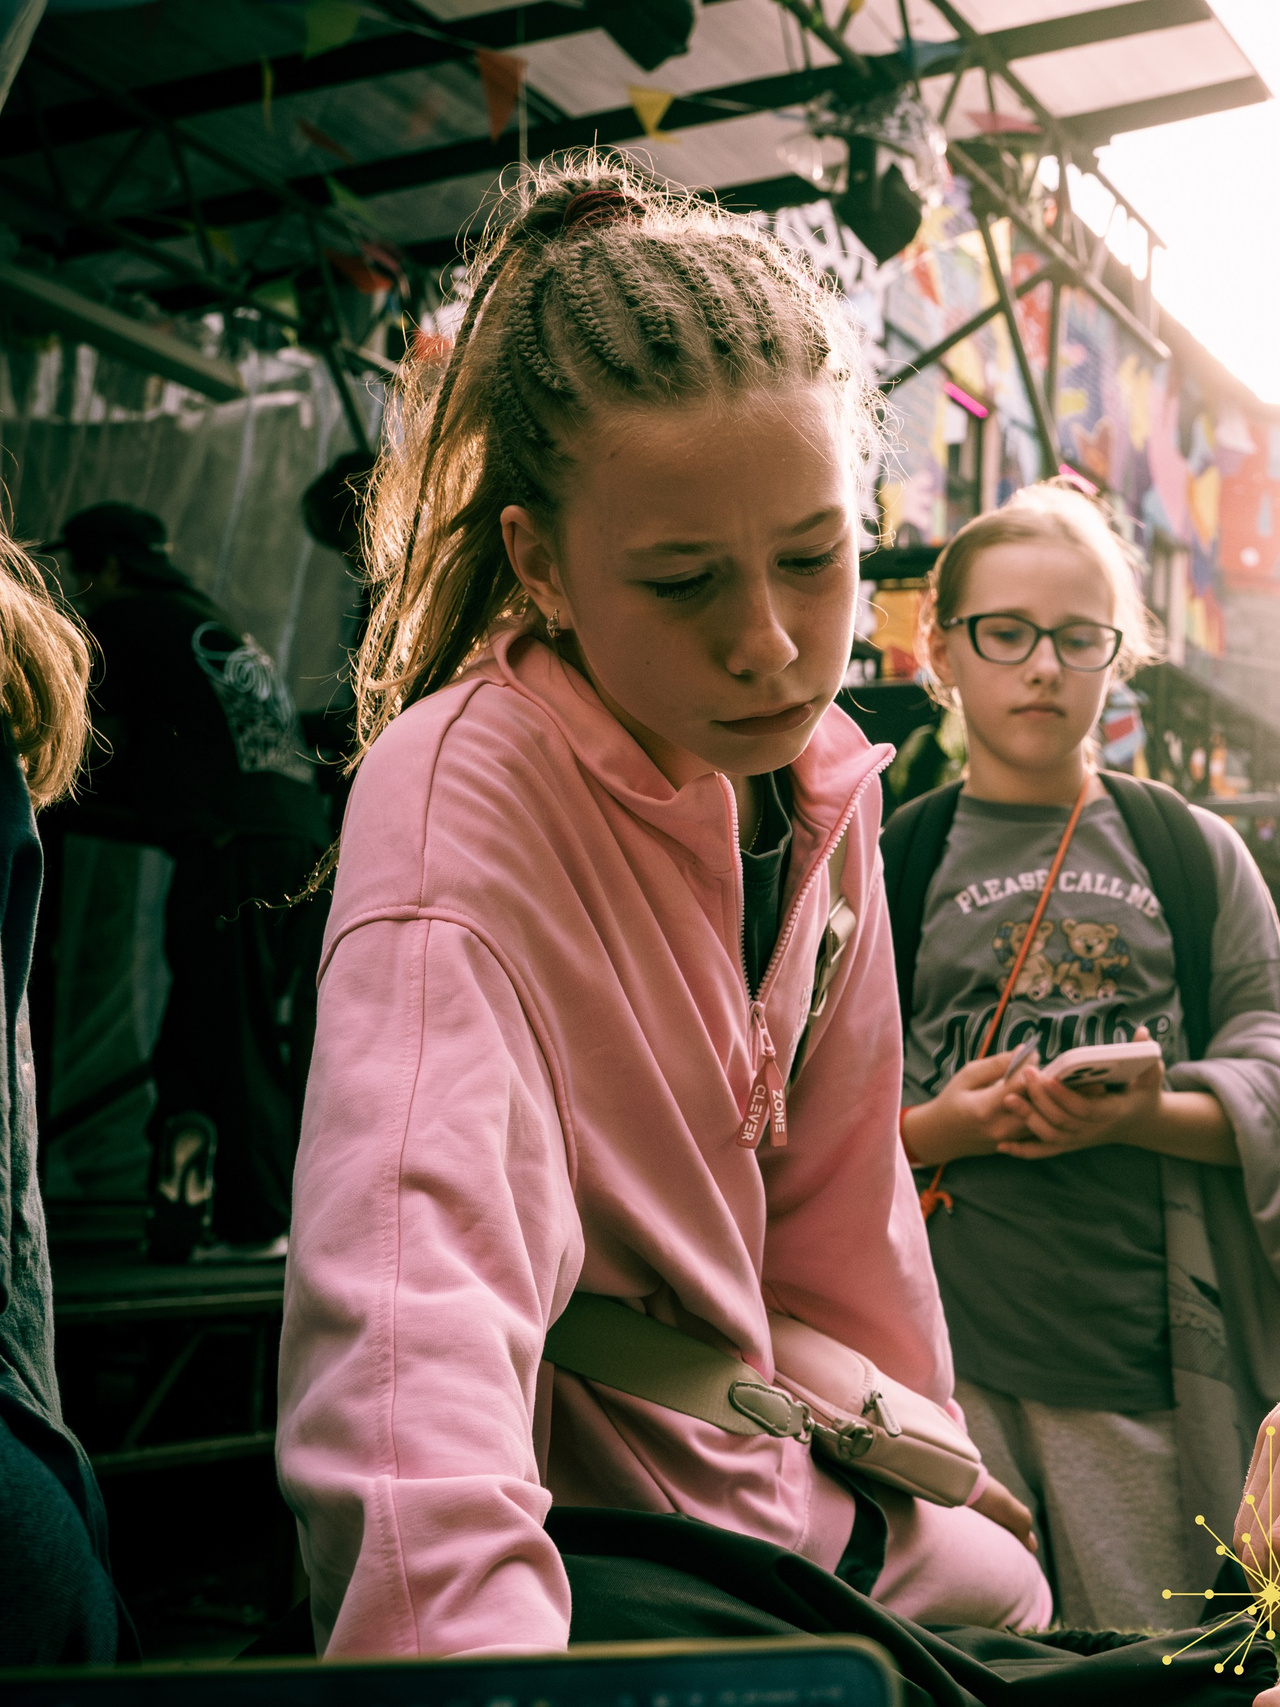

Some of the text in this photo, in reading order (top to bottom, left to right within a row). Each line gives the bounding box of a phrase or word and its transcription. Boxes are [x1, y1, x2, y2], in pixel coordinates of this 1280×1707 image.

[954, 868, 1053, 915] PLEASE
[1058, 870, 1124, 900] CALL
[741, 1084, 767, 1141] CLEVER
[772, 1089, 785, 1134] ZONE
